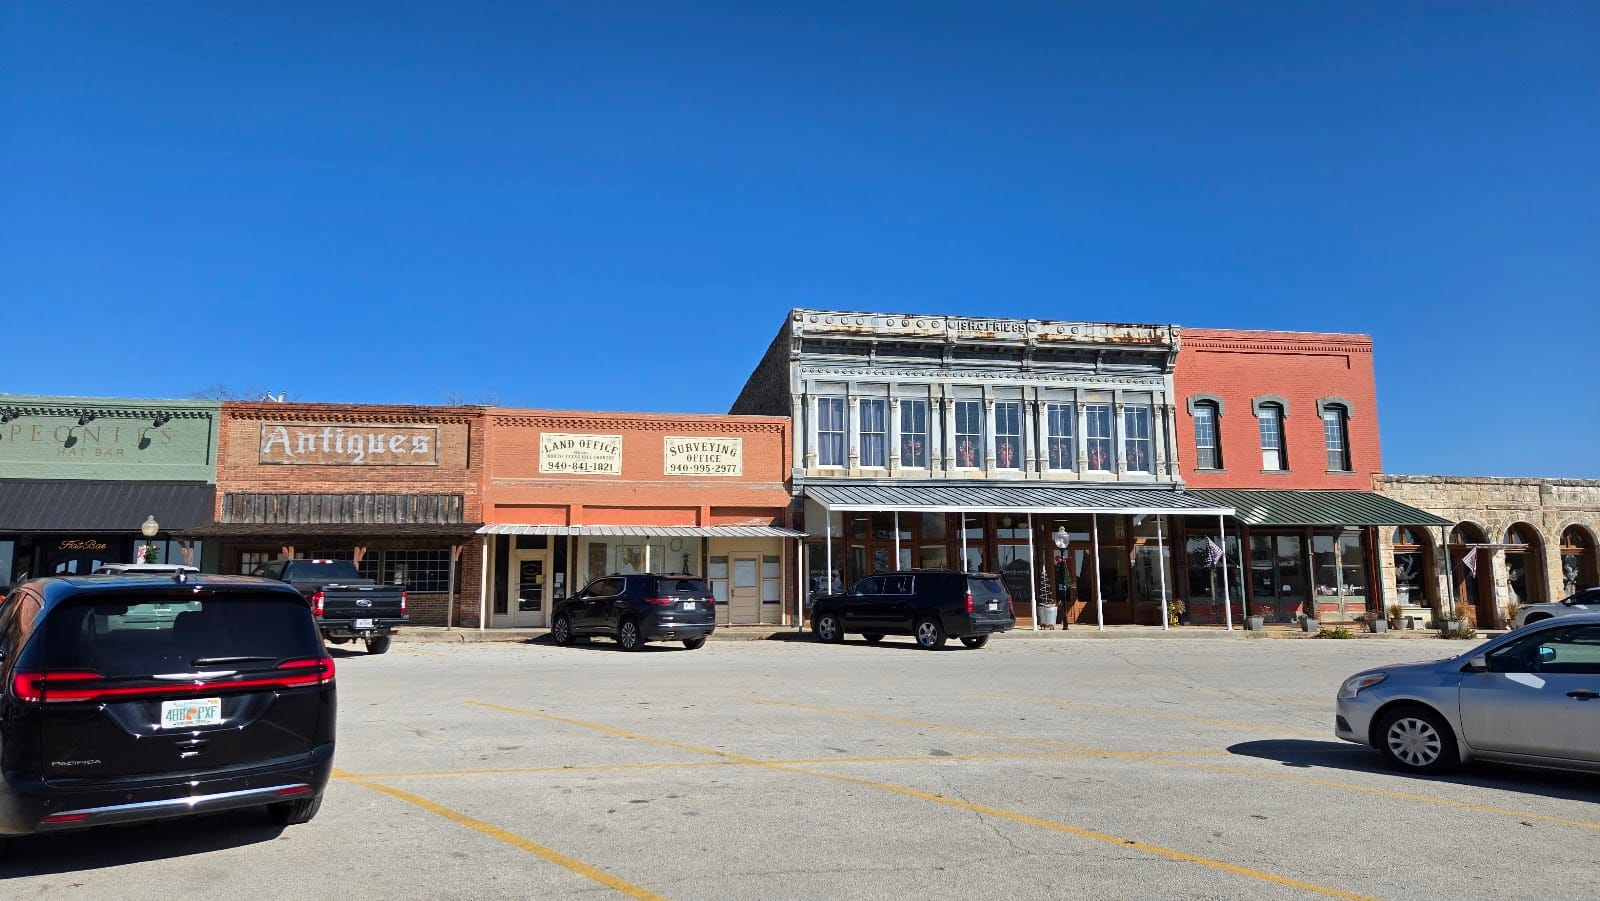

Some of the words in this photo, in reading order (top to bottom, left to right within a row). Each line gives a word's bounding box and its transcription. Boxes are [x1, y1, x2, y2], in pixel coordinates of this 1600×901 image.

[9, 424, 173, 444] PEONIES
[263, 425, 431, 463] Antiques
[544, 439, 575, 454] LAND
[579, 439, 619, 455] OFFICE
[669, 442, 737, 457] SURVEYING
[57, 447, 86, 457] HAT
[95, 448, 125, 458] BAR
[686, 454, 721, 463] OFFICE
[198, 706, 217, 720] PXF
[51, 759, 102, 767] PACIFICA
